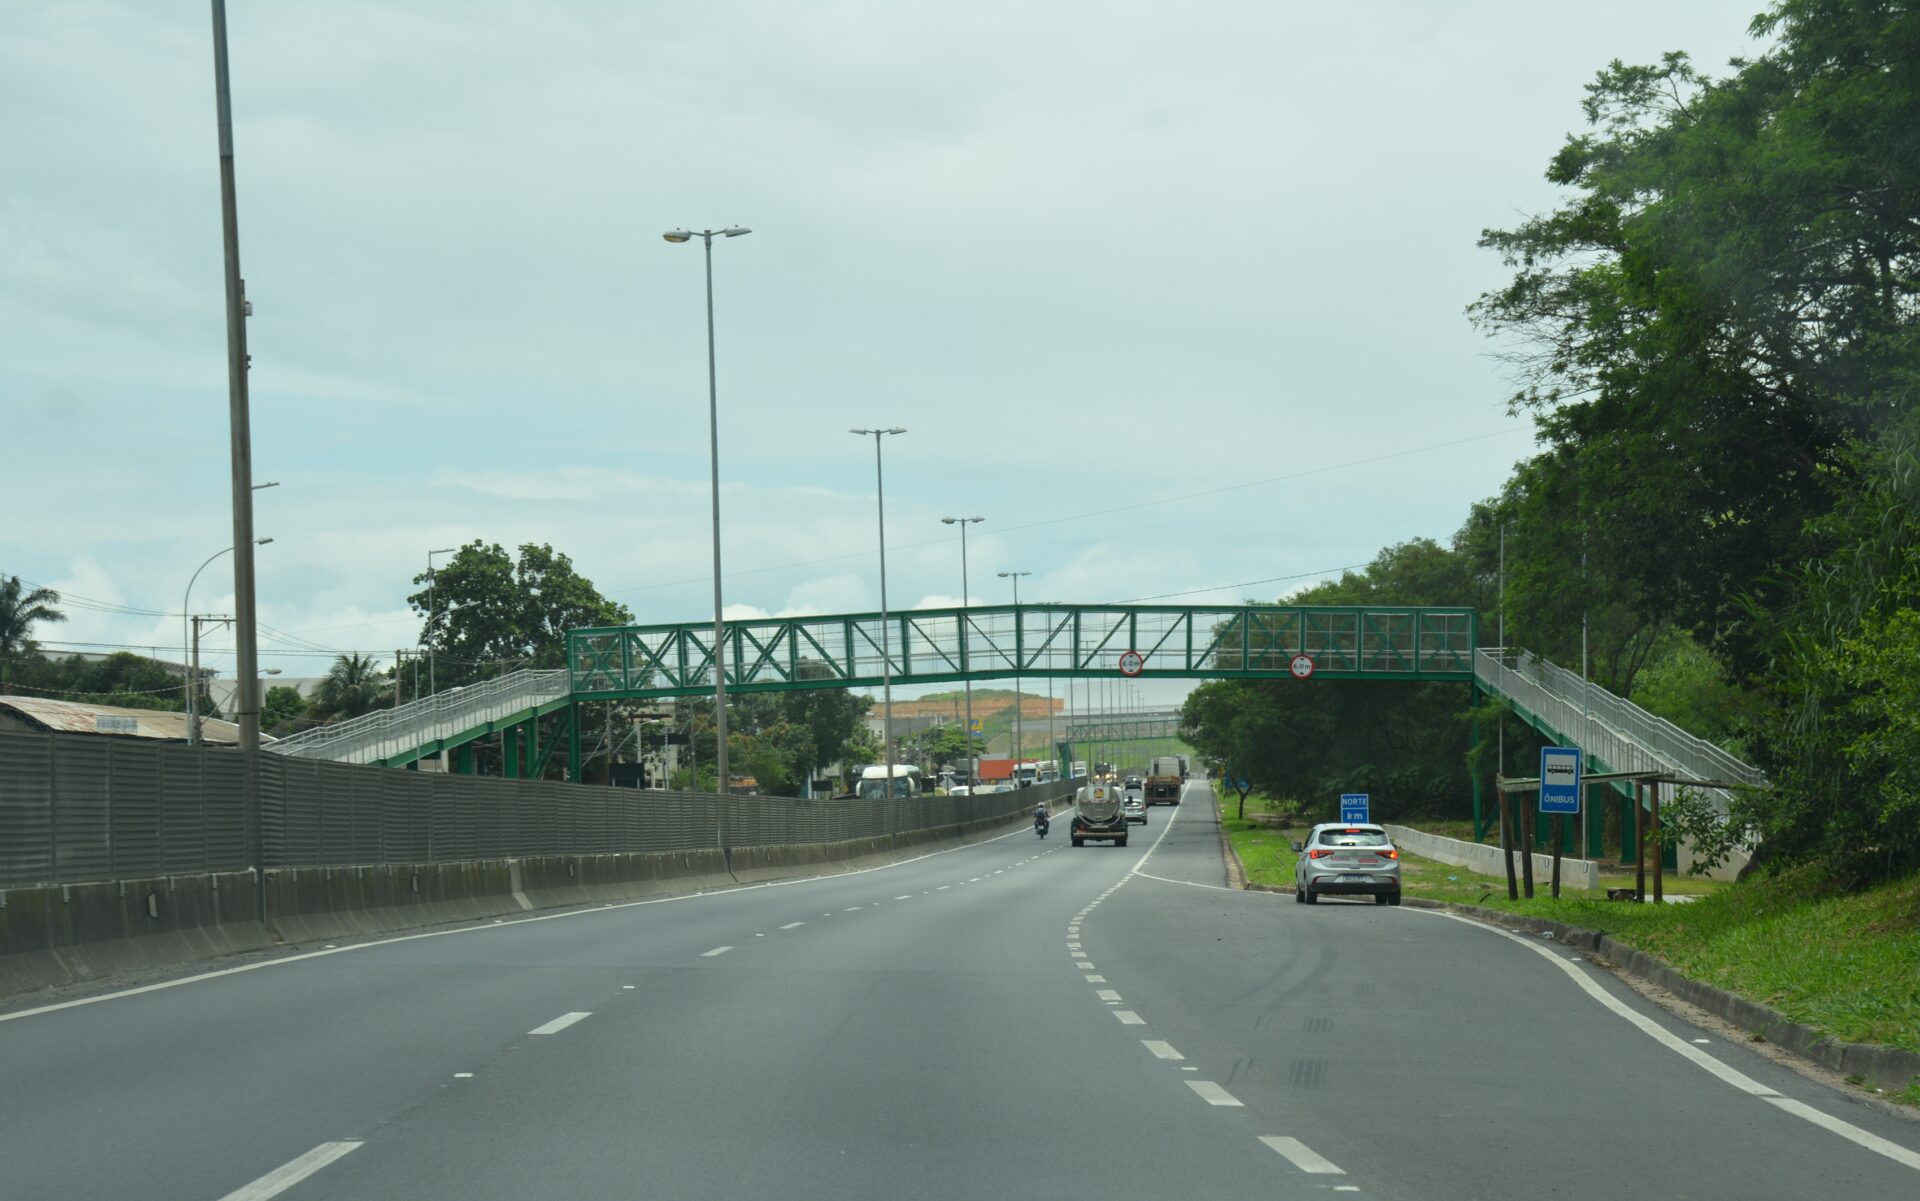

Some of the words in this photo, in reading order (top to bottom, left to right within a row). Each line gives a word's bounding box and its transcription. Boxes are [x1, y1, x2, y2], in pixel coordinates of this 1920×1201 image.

[1342, 797, 1367, 806] NORTE
[1544, 793, 1575, 804] ÔNIBUS
[1347, 812, 1363, 820] km
